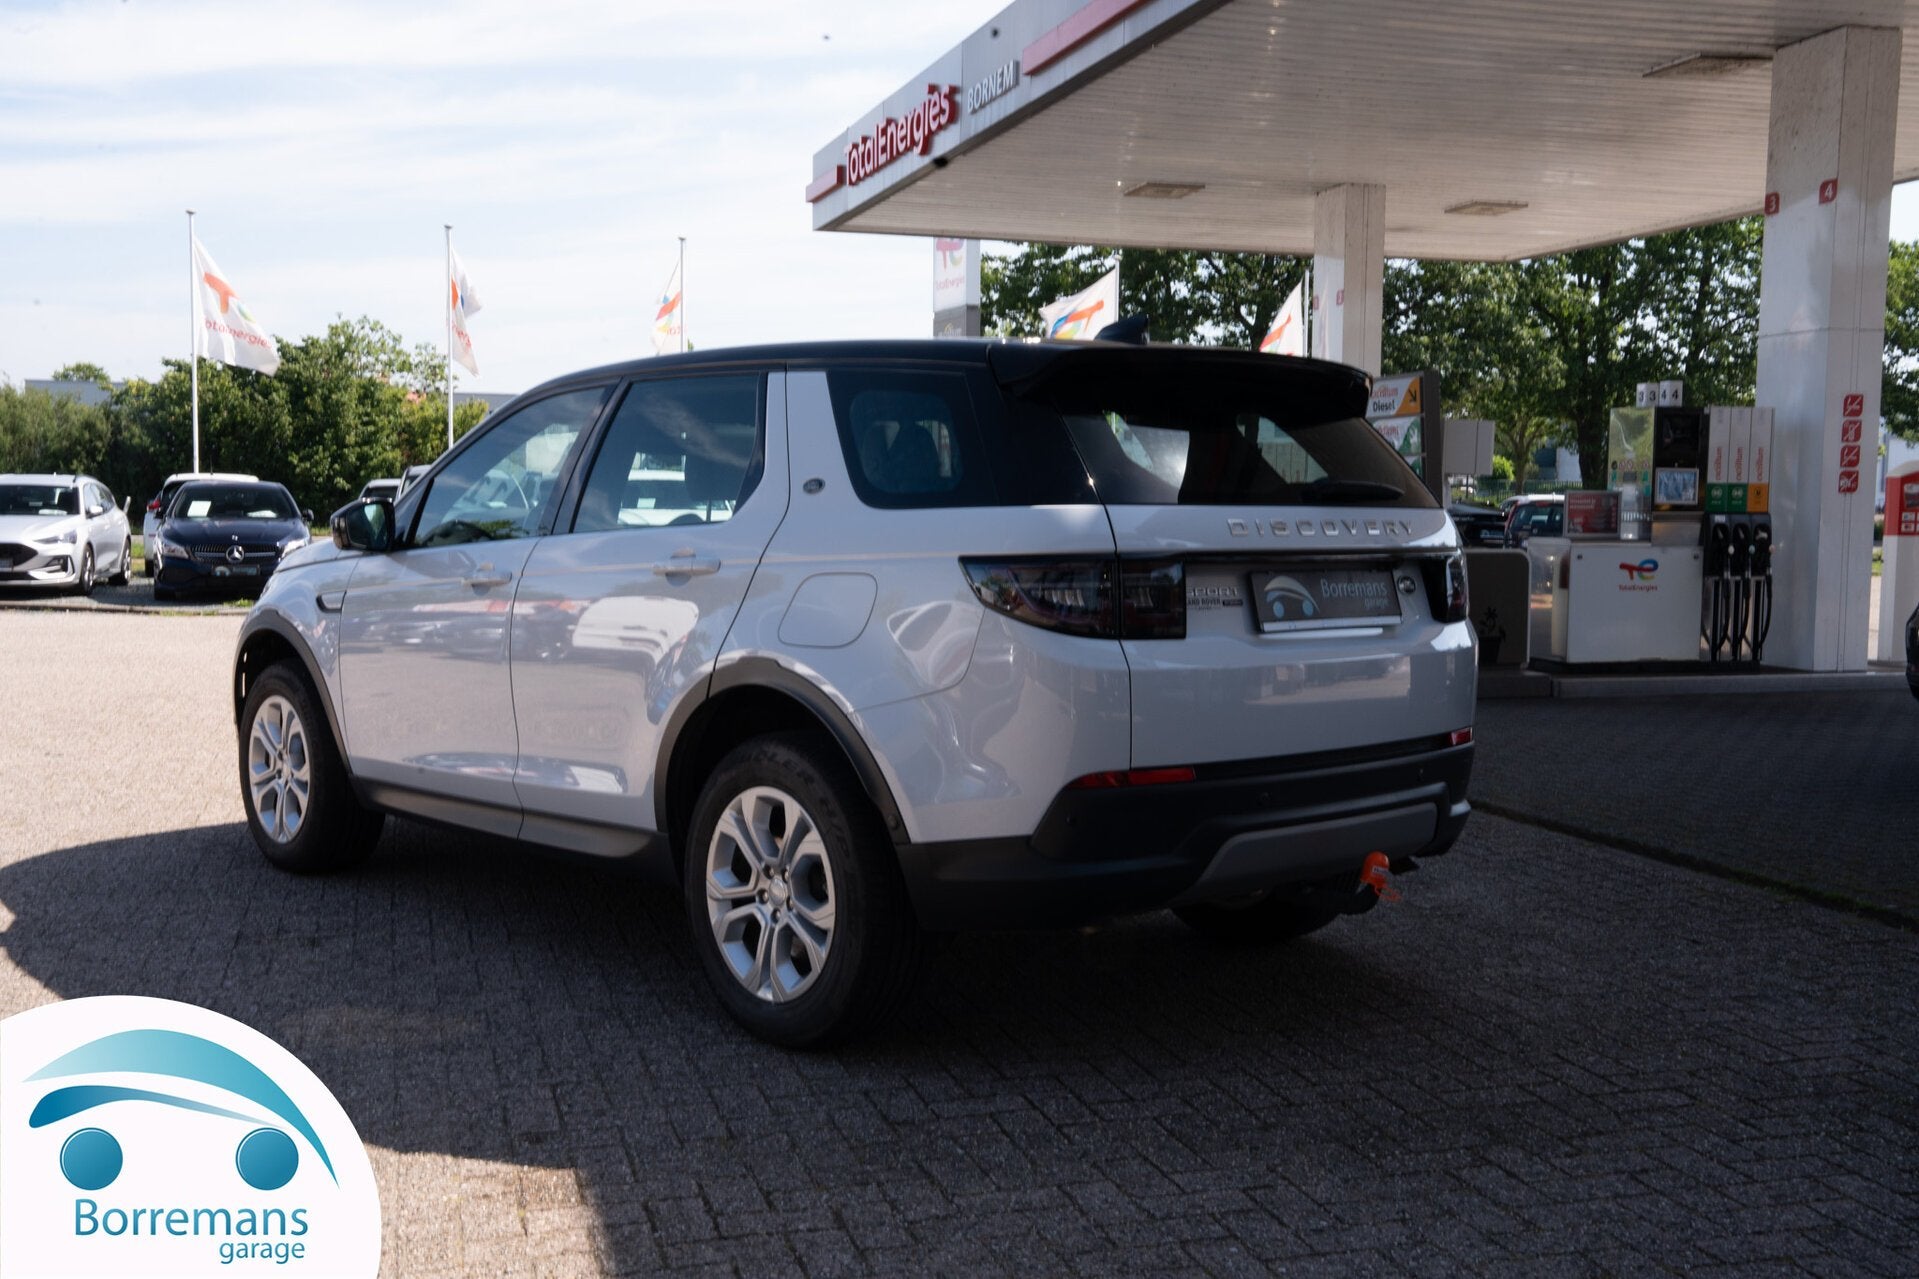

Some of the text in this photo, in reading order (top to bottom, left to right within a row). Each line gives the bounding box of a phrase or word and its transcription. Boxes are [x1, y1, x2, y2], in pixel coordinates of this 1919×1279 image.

[967, 60, 1018, 114] BORNEM
[844, 84, 957, 186] TotalEnergies
[1373, 400, 1395, 412] Diesel
[1227, 517, 1413, 538] DISCOVERY
[1320, 577, 1388, 599] Borremans
